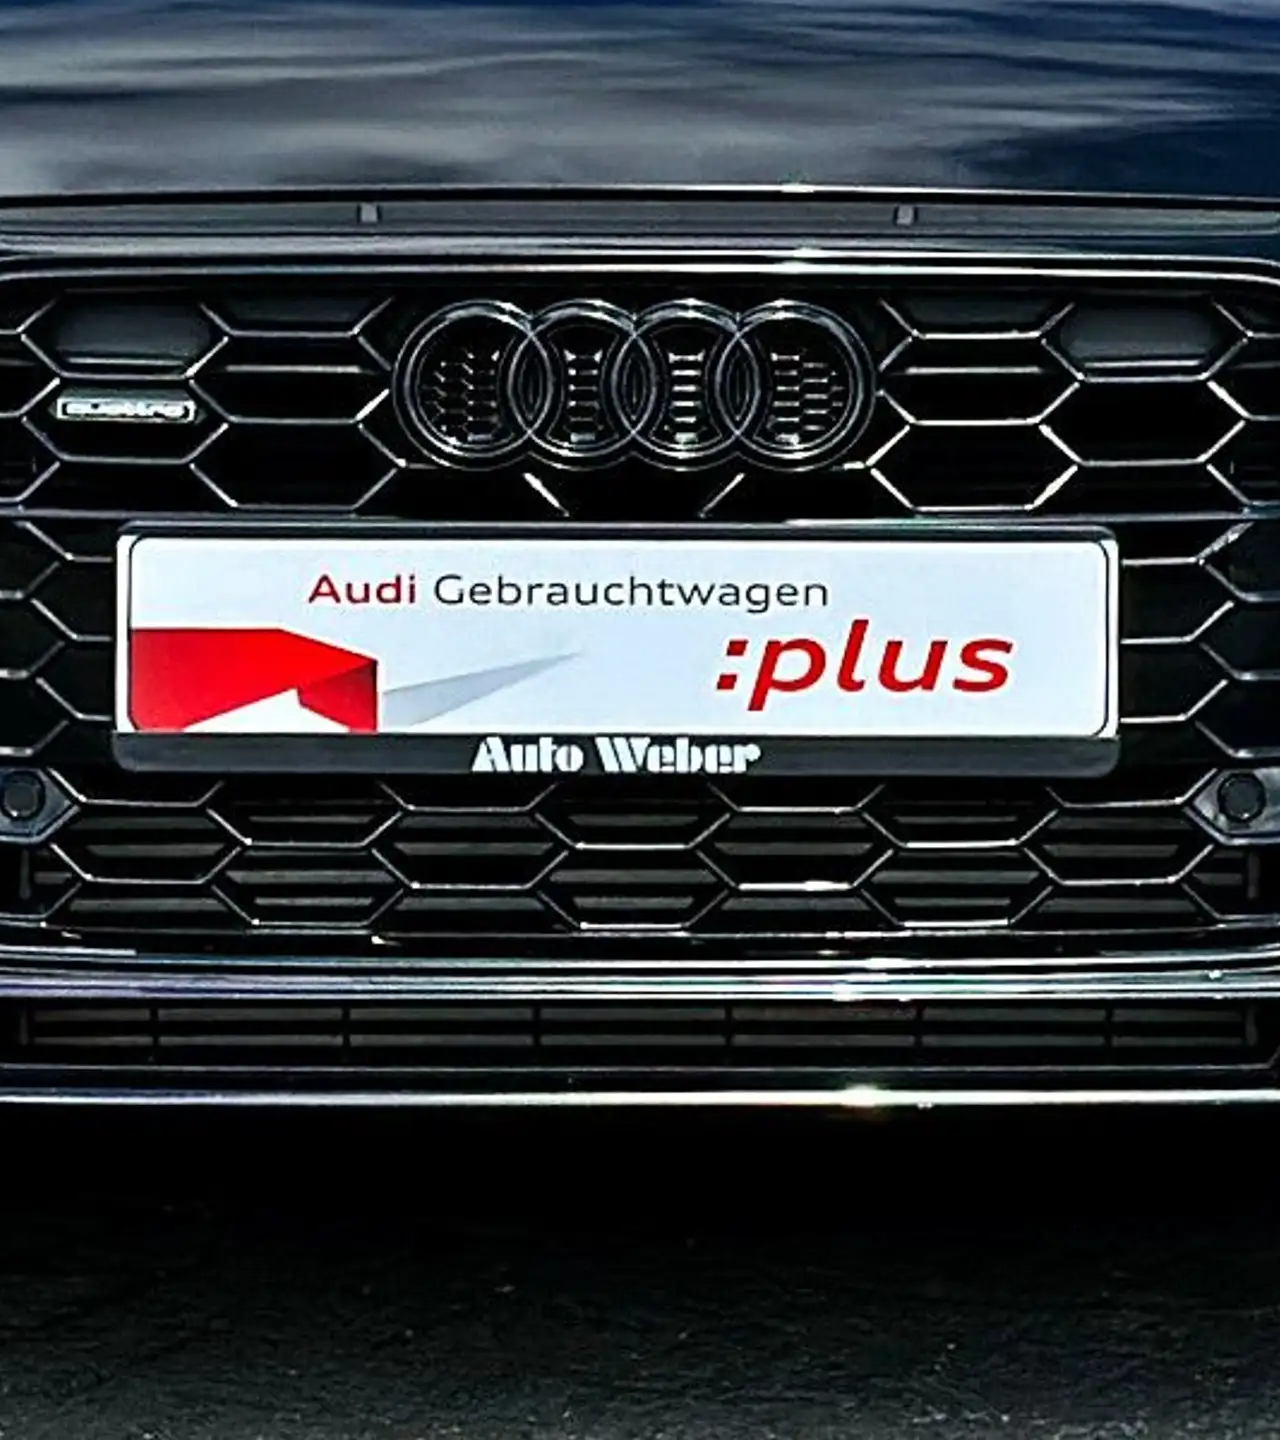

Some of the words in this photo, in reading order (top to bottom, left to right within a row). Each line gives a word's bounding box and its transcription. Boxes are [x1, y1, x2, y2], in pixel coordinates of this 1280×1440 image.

[308, 574, 417, 605] Audi
[433, 573, 829, 614] Gebrauchtwagen
[716, 618, 1014, 712] :plus
[471, 736, 584, 773] Auto
[594, 736, 762, 774] Weber
